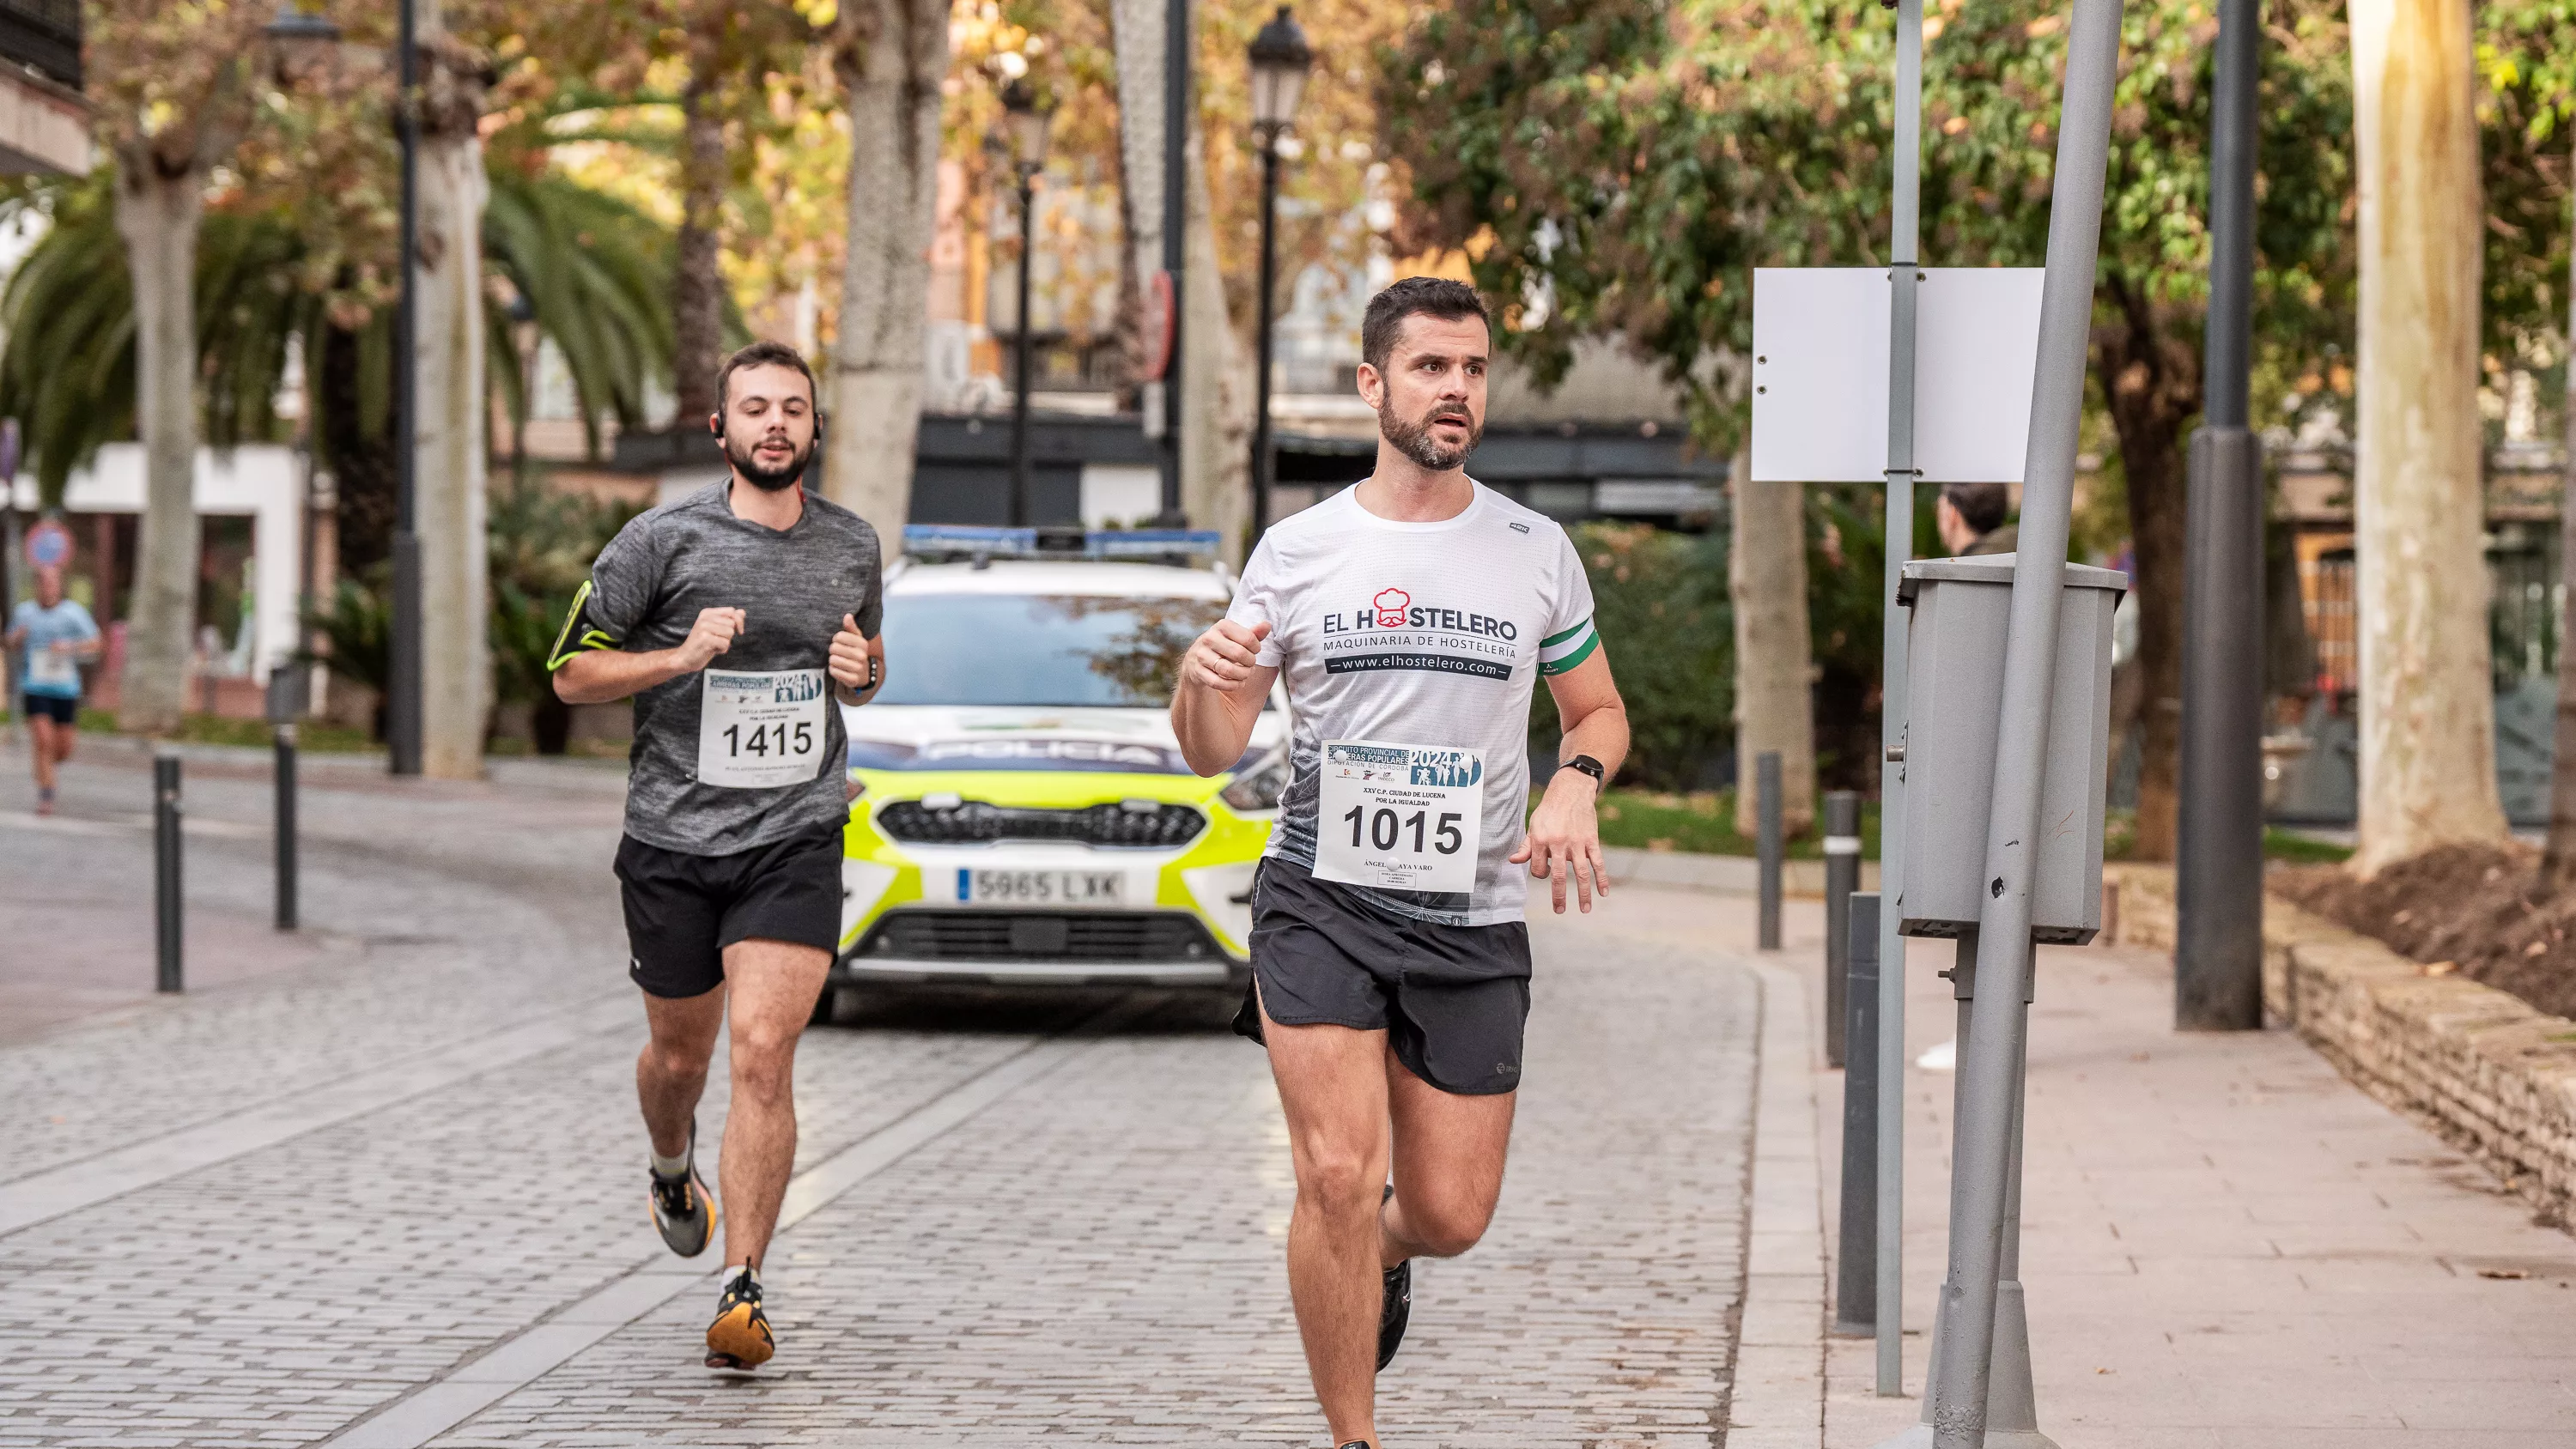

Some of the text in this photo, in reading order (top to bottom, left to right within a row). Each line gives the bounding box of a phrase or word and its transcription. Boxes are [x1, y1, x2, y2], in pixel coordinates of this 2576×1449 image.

[1323, 614, 1349, 634] EL
[1323, 635, 1516, 659] MAQUINARIA DE HOSTELERÍA
[1342, 655, 1498, 675] www.elhostelero.com
[722, 721, 812, 757] 1415
[1327, 745, 1358, 754] CIRCUITO
[1360, 747, 1399, 757] PROVINCIAL
[1327, 751, 1409, 766] CAERAS POPULARES
[1411, 750, 1451, 767] 2024
[1344, 804, 1463, 856] 1015
[1364, 858, 1387, 868] ÁNGEL
